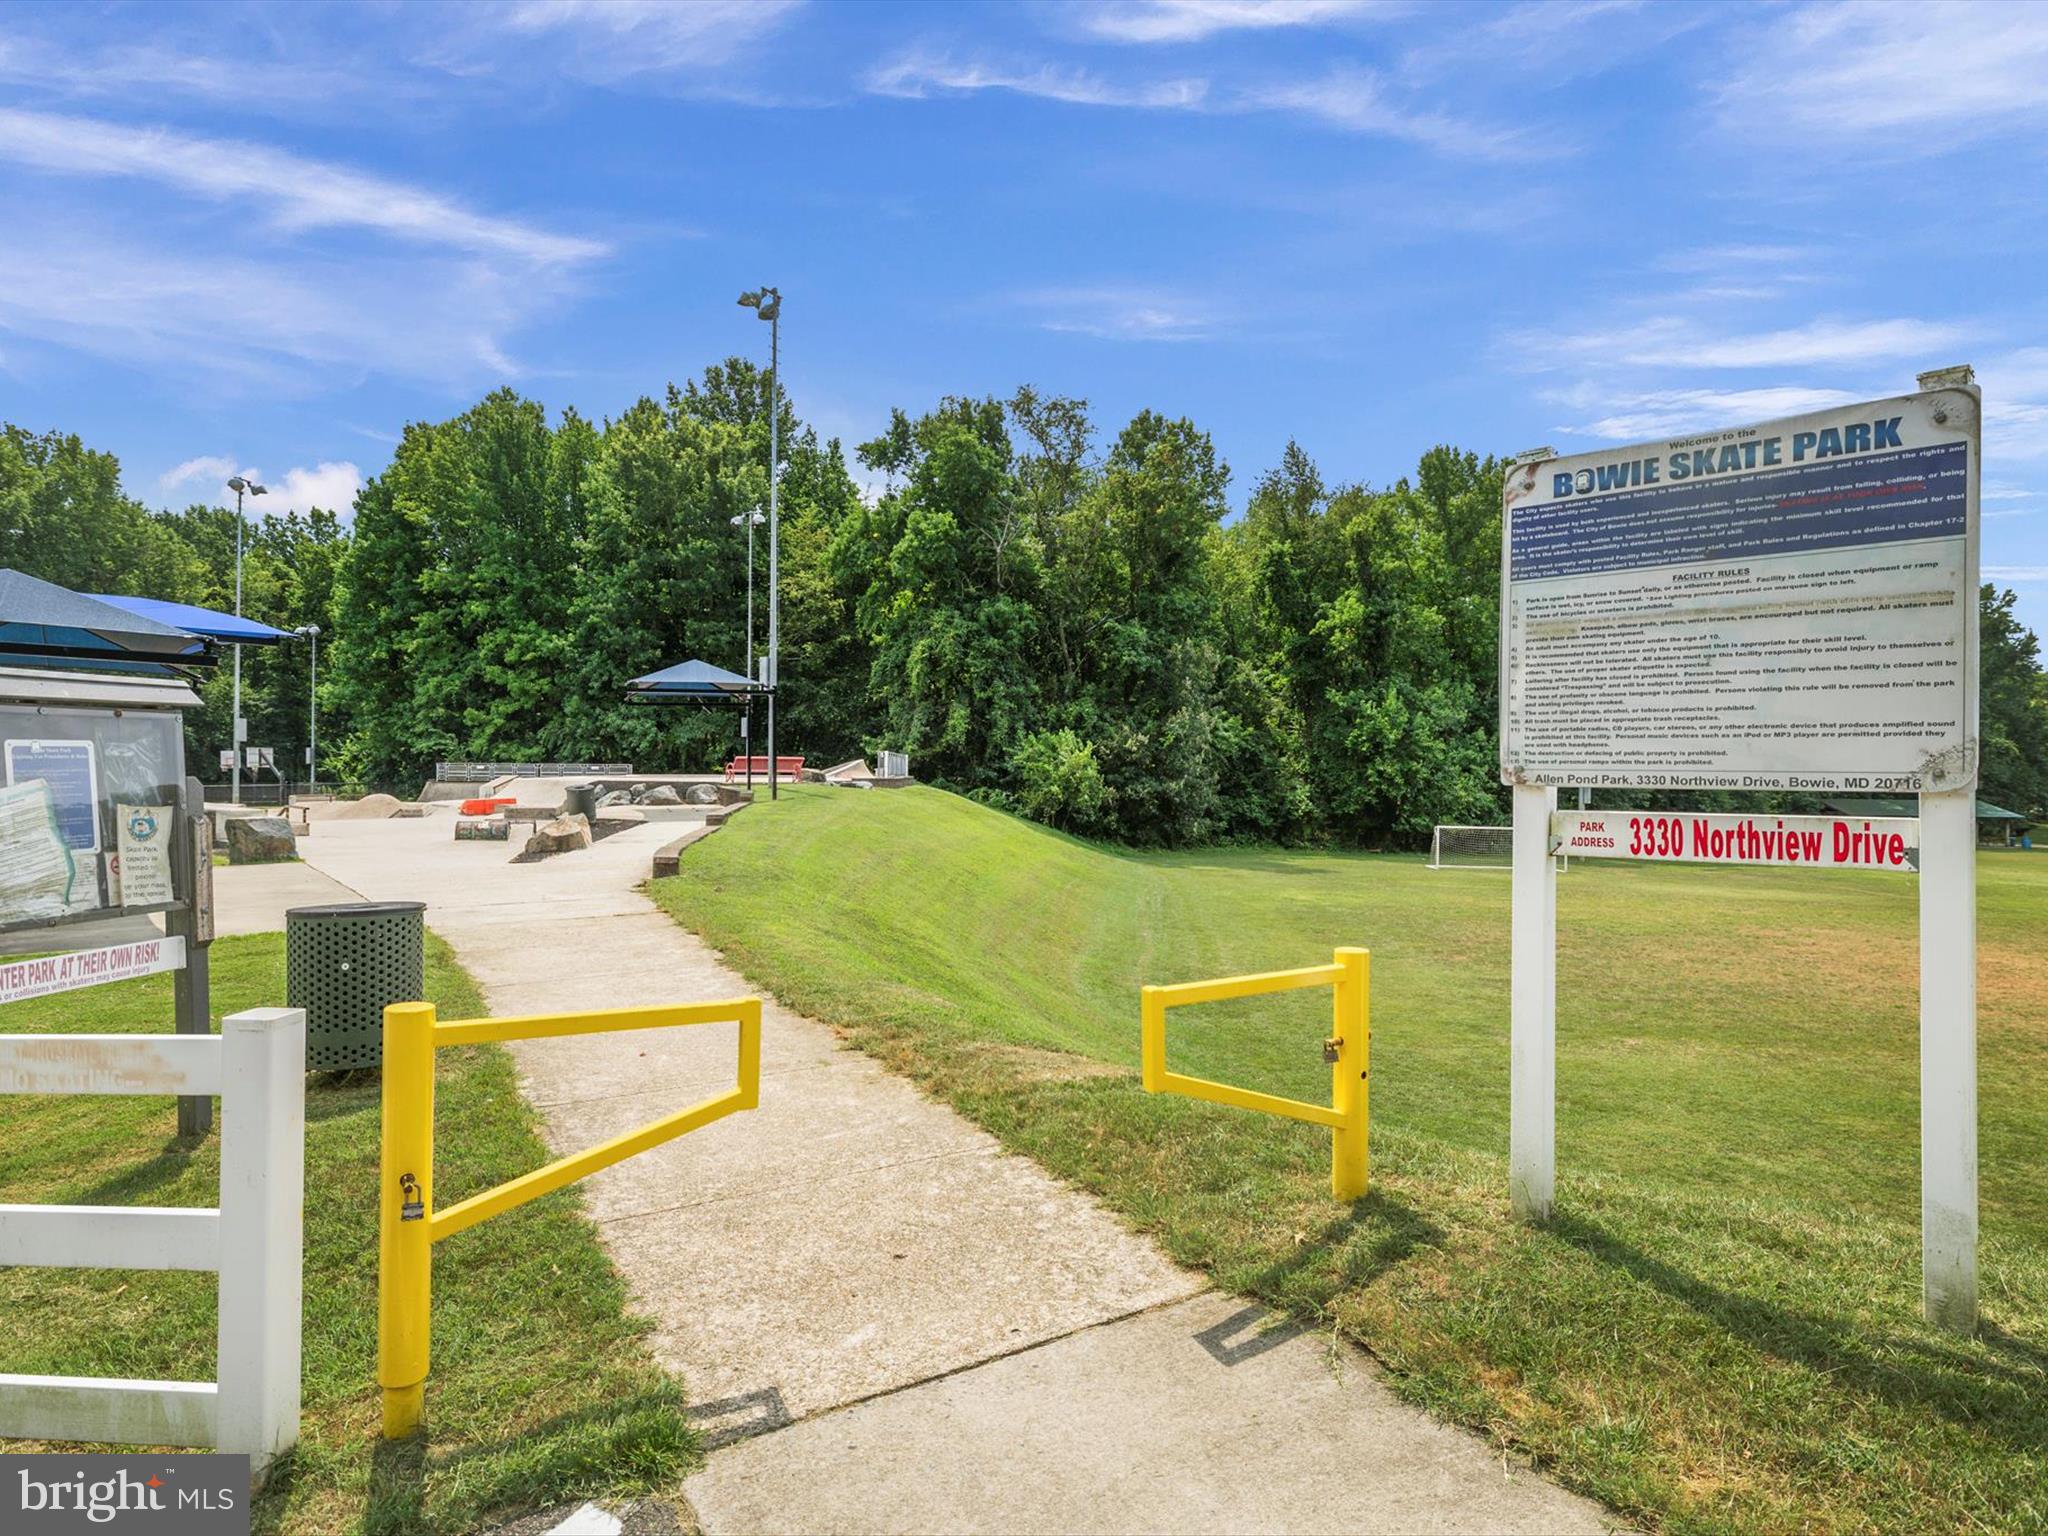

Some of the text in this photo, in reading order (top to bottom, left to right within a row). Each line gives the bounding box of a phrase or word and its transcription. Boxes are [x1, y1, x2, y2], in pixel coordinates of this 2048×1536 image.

[1669, 429, 1756, 450] Welcome to the
[1553, 416, 1903, 499] BOWIE SKATE PARK
[1672, 567, 1750, 582] FACILITY RULES
[1535, 775, 1922, 790] Allen Pond Park, 3330 Northview Drive, Bowie, MD 20716
[1580, 822, 1605, 832] PARK
[1571, 836, 1615, 848] ADDRESS
[1629, 817, 1905, 866] 3330 Northview Drive
[28, 959, 57, 985] PARK
[60, 956, 74, 979] AT
[77, 951, 108, 977] THEIR
[110, 946, 133, 970] OWN
[135, 941, 160, 966] RISK!
[14, 985, 50, 998] collisions
[51, 980, 68, 990] with
[69, 976, 95, 987] skaters
[96, 973, 110, 984] may
[111, 970, 131, 979] cause
[133, 966, 150, 977] injury
